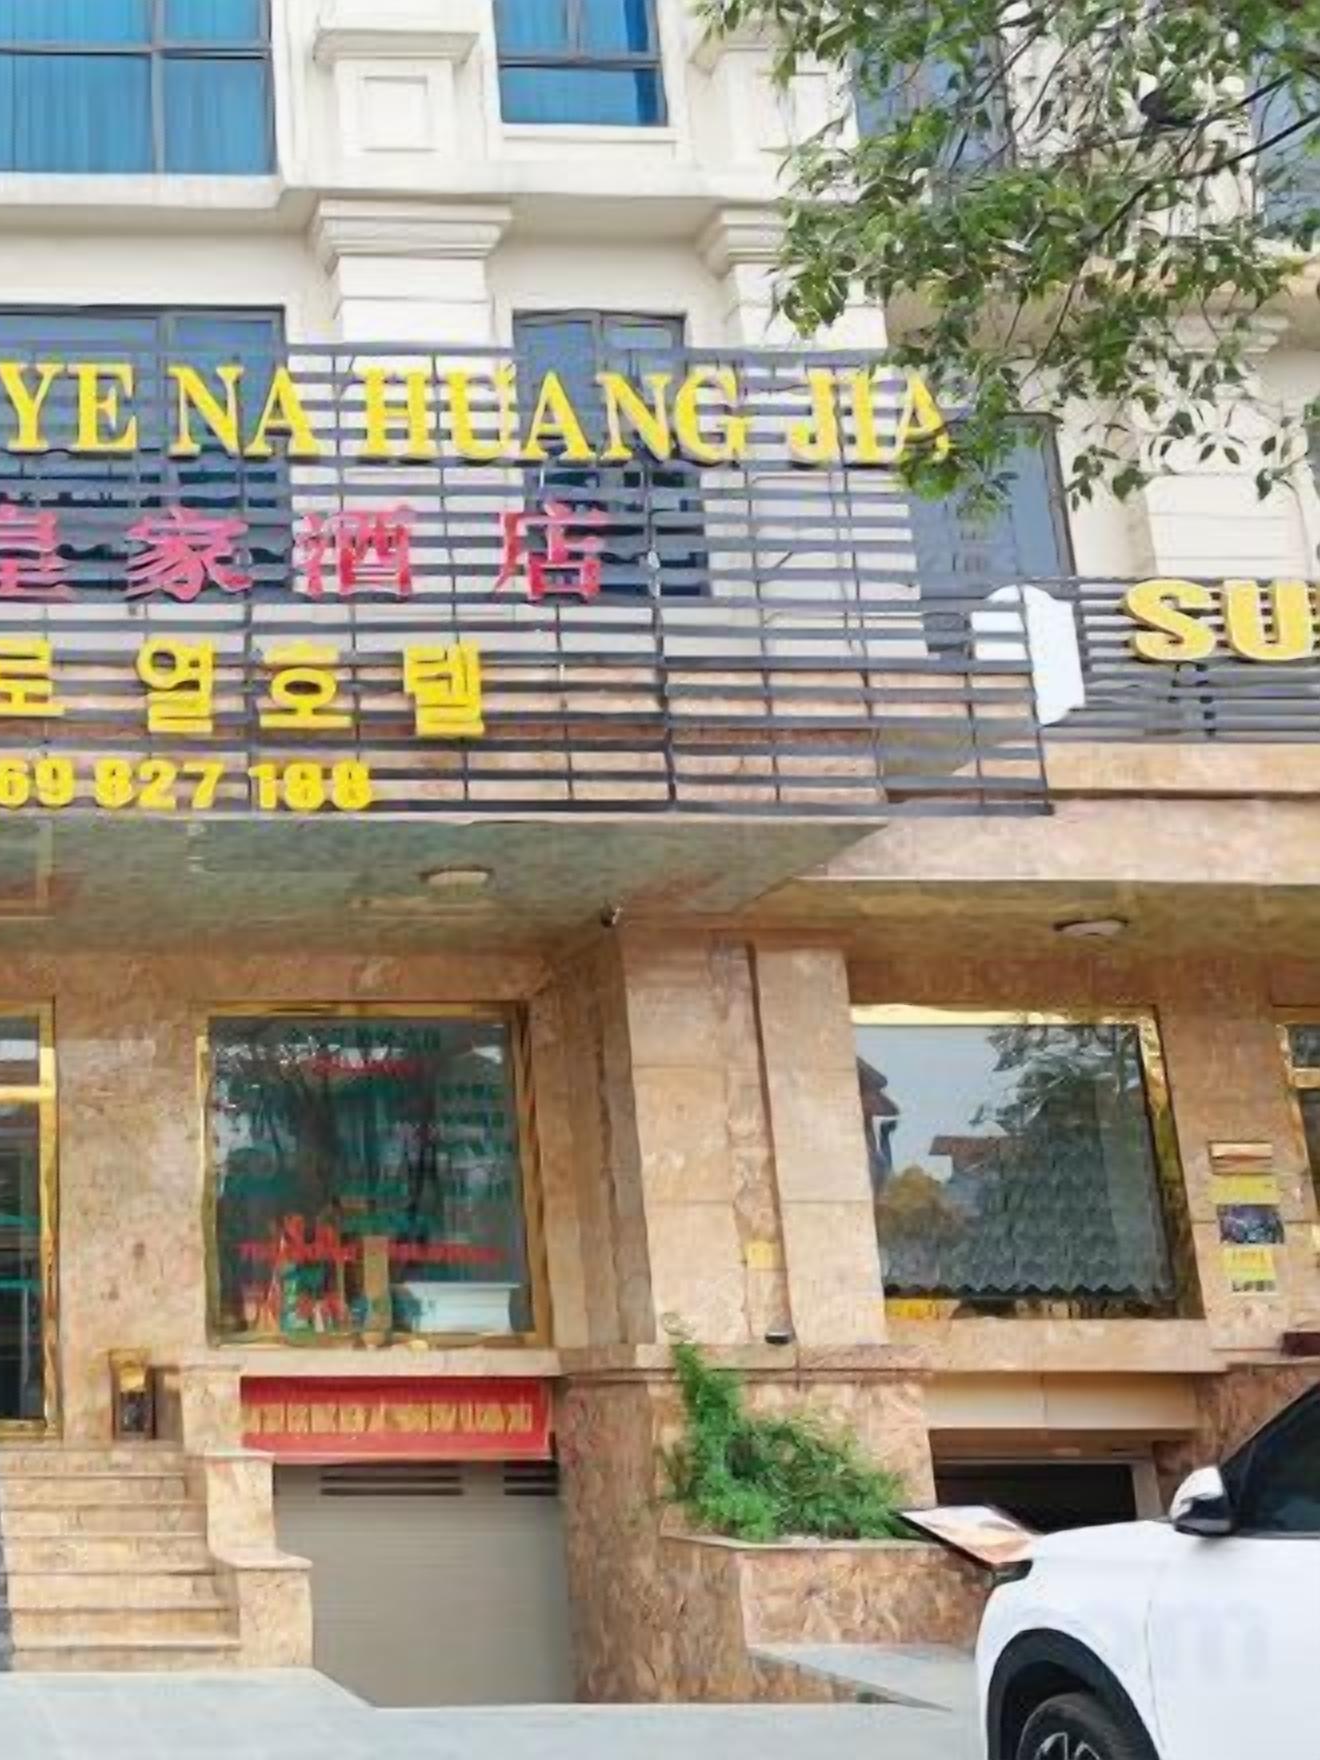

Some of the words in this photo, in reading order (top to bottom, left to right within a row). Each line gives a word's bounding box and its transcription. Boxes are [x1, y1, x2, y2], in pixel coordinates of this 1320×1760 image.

[167, 363, 325, 459] NA
[354, 365, 752, 465] HUANG
[788, 364, 951, 465] JIA
[93, 757, 226, 811] 827
[247, 758, 373, 812] 188
